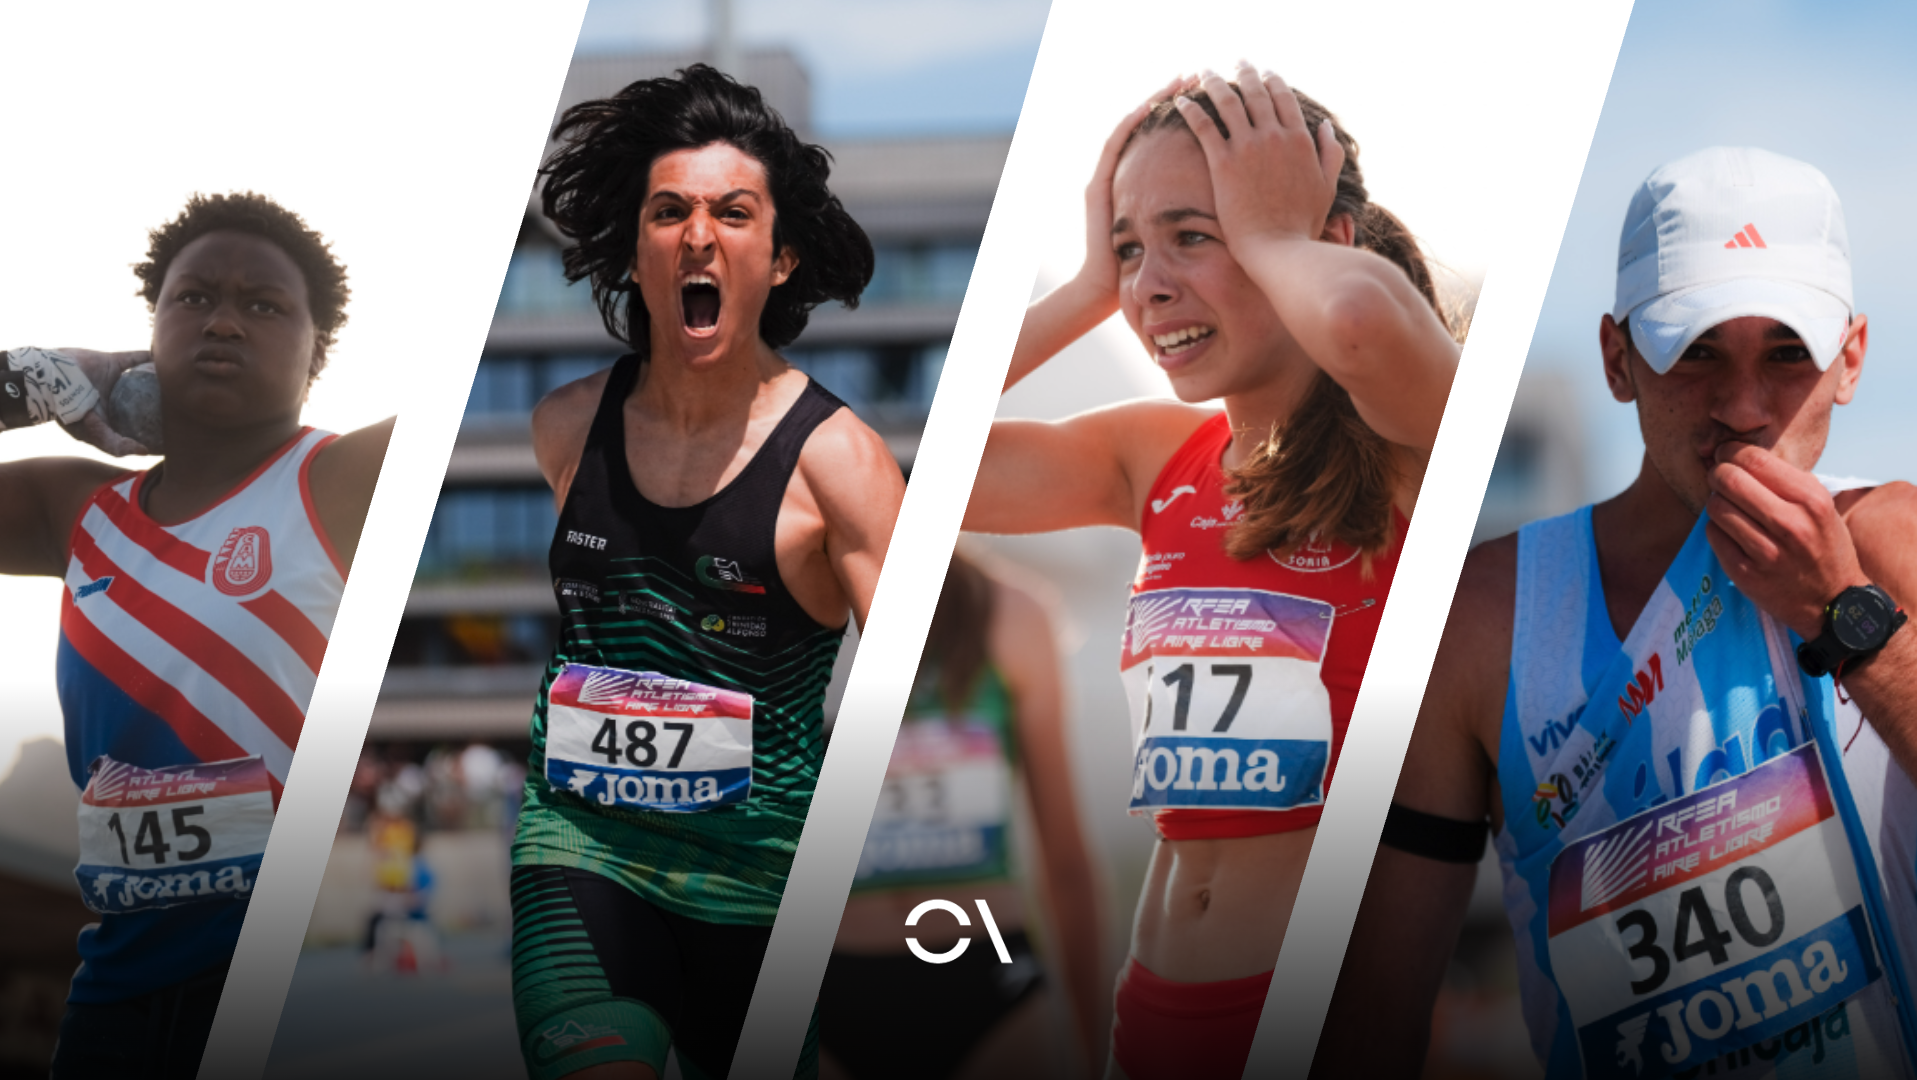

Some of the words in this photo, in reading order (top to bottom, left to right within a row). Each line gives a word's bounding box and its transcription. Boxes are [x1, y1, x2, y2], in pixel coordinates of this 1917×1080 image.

[566, 530, 608, 550] FASTER
[1171, 618, 1277, 632] ATLETISMO
[1181, 598, 1252, 616] RFEA
[1673, 575, 1712, 644] metro
[1162, 636, 1207, 650] AIRE
[1209, 637, 1264, 652] LIBRE
[630, 690, 716, 701] ATLETISMO
[1144, 664, 1253, 732] 17
[591, 718, 694, 769] 487
[126, 788, 161, 802] AIRE
[166, 781, 217, 797] LIBRE
[597, 773, 723, 806] Joma
[1656, 789, 1738, 837] RFEA
[107, 805, 212, 865] 145
[1653, 851, 1700, 882] AIRE
[1709, 821, 1774, 862] LIBRE
[1654, 795, 1781, 860] ATLETISMO
[118, 865, 250, 906] Joma
[1615, 865, 1785, 996] 340
[1656, 940, 1848, 1064] Joma
